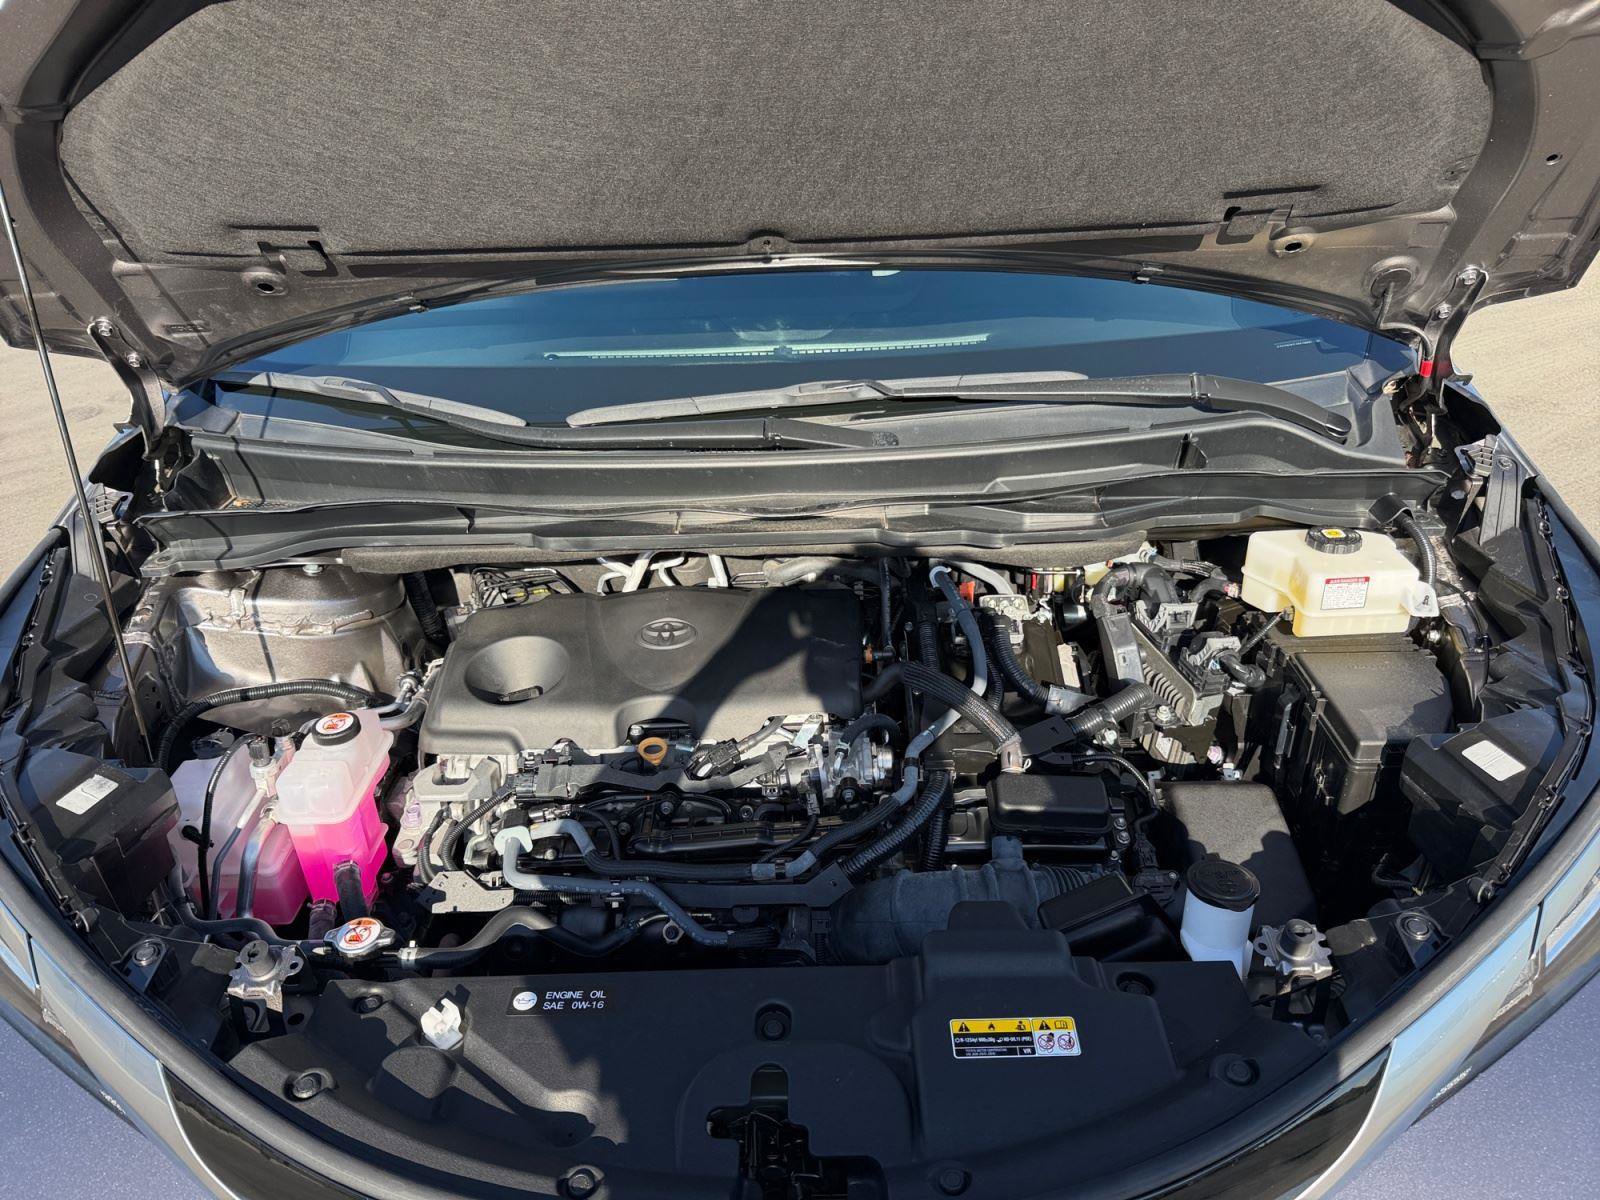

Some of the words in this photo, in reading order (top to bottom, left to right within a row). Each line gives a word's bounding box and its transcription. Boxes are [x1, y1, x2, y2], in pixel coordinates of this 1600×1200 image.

[545, 991, 584, 999] ENGINE
[589, 990, 607, 999] OIL
[542, 1001, 565, 1010] SAE
[571, 1000, 605, 1009] 0W-16
